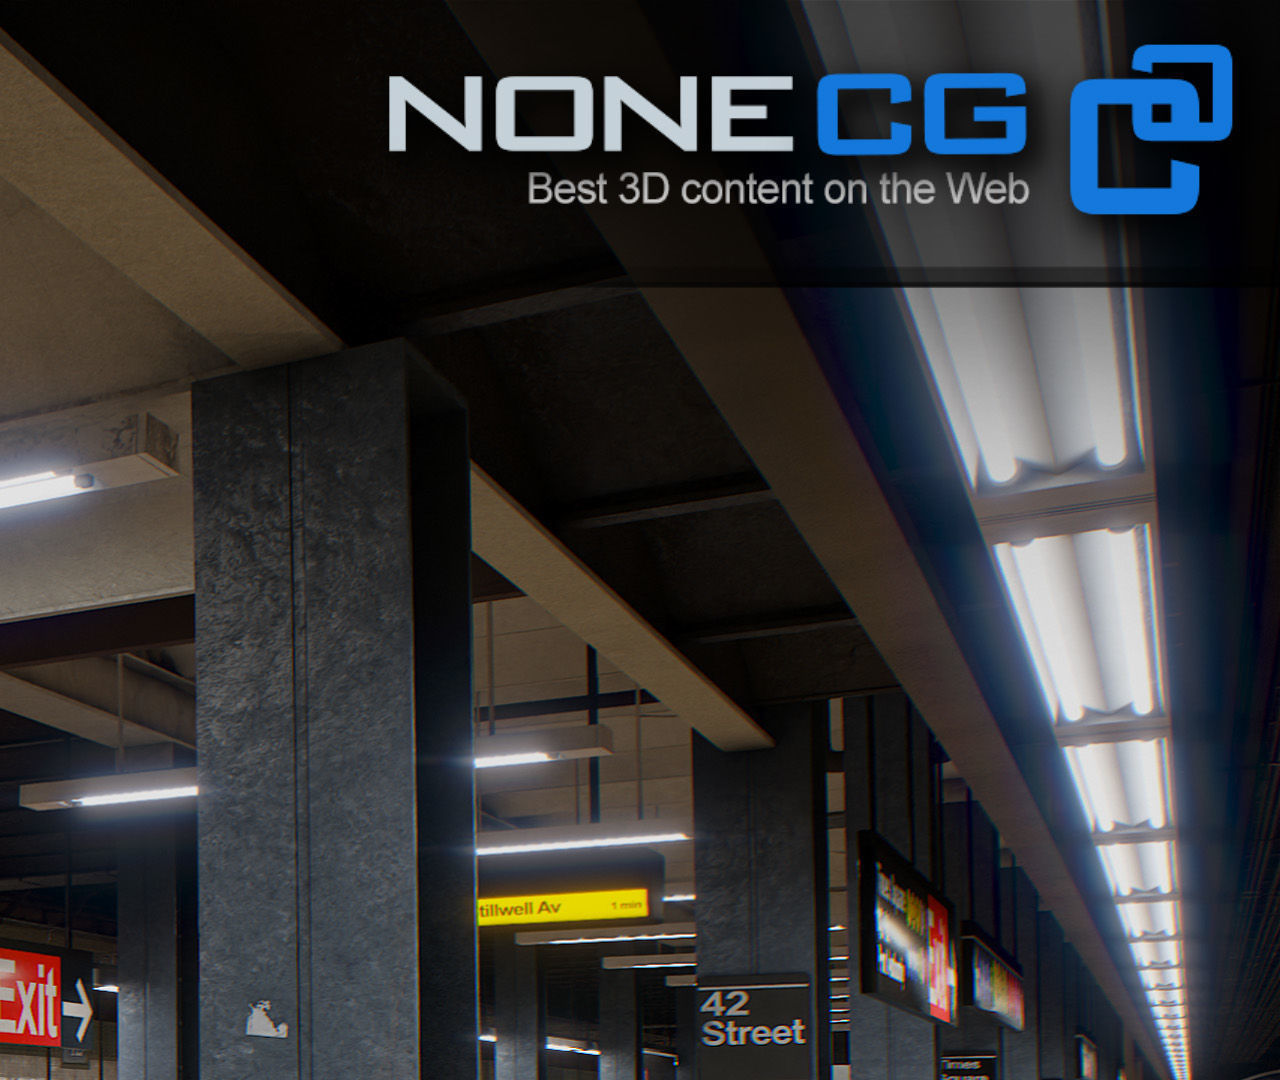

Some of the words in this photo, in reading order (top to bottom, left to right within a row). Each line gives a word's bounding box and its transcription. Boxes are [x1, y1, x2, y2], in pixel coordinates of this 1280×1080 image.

[537, 900, 562, 915] Av
[620, 901, 643, 911] min
[700, 990, 750, 1017] 42
[701, 1018, 807, 1047] Street
